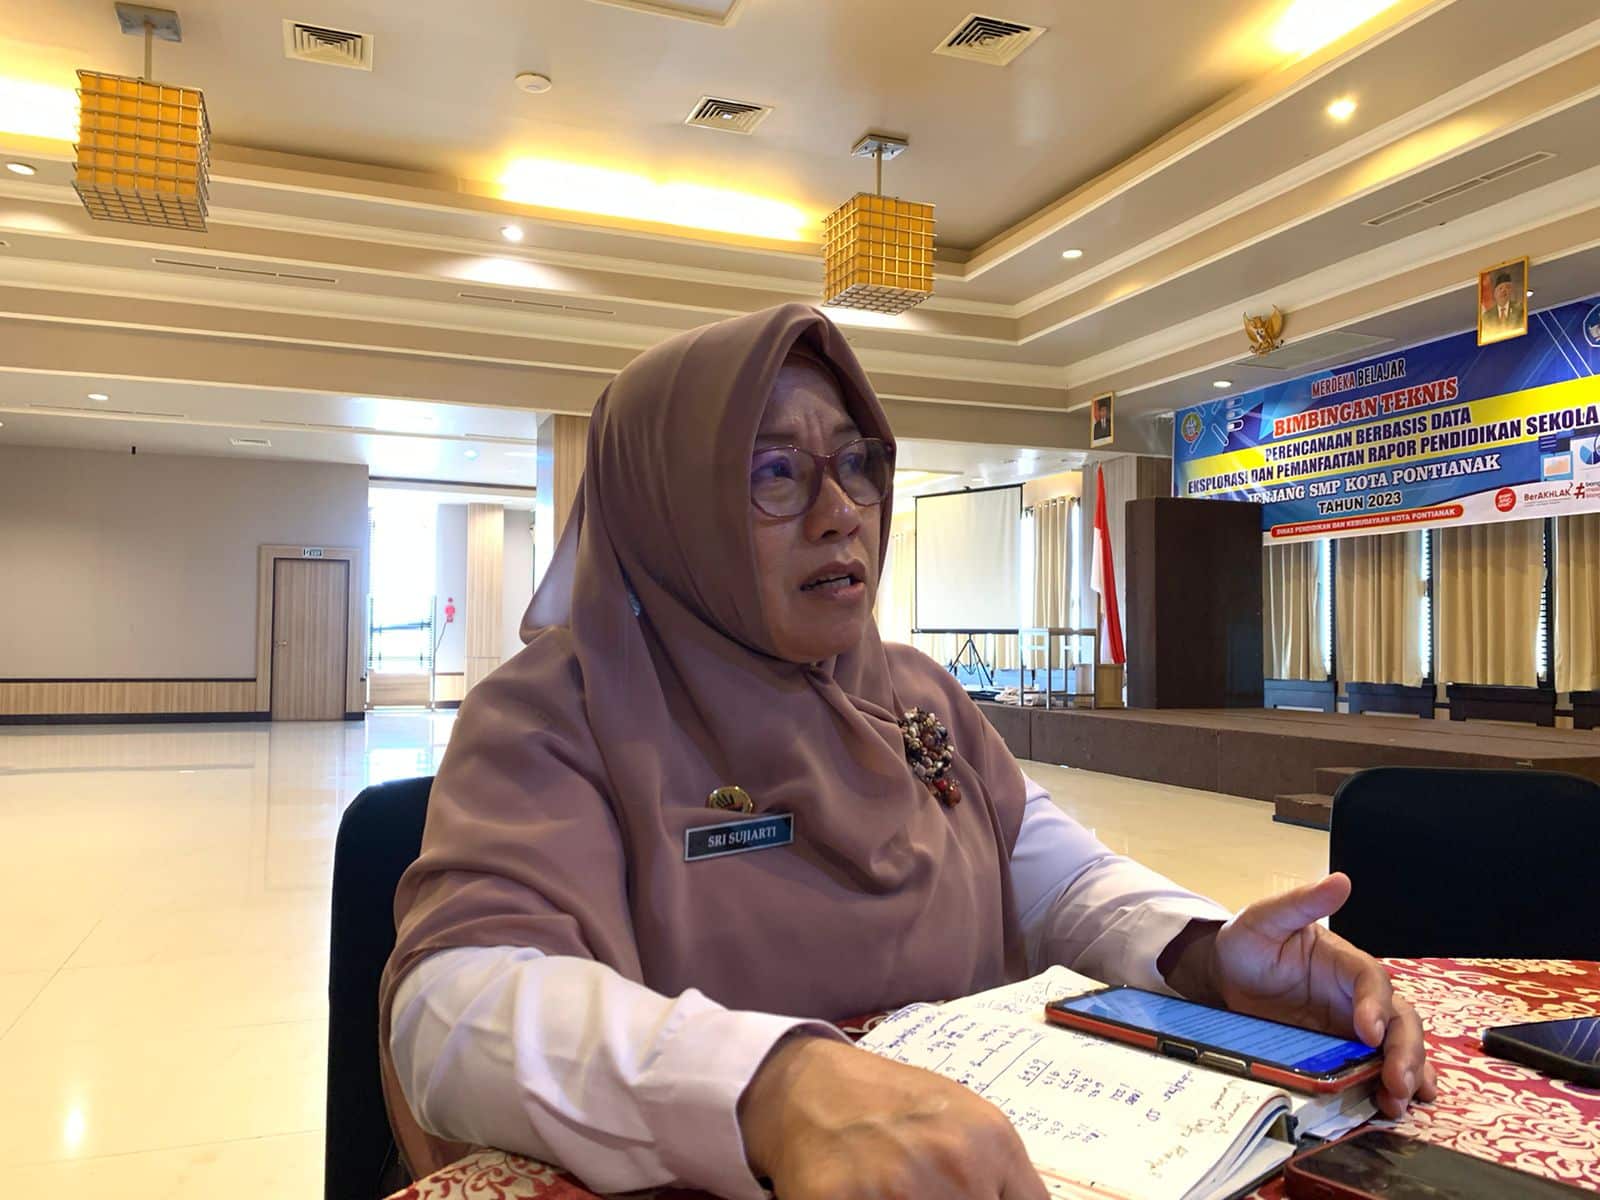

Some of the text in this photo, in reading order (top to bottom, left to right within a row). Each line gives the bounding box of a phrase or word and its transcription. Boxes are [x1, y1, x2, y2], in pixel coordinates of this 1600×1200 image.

[1311, 358, 1406, 398] MERDEKA BELAJAR
[1274, 376, 1459, 437] BIMBINGAN TEKNIS
[1188, 470, 1248, 494] EKSPLORASI
[1251, 465, 1274, 484] DAN
[1276, 448, 1365, 480] PEMANFAATAN
[1367, 438, 1417, 464] RAPOR
[1420, 419, 1522, 454] PENDIDIKAN
[1265, 406, 1472, 462] PERENCANAAN BERBASIS DATA
[1308, 479, 1341, 498] SMP
[1344, 470, 1389, 493] KOTA
[1391, 453, 1501, 486] PONTIANAK
[1317, 490, 1403, 515] TAHUN 2023
[708, 826, 777, 848] SRI SUJIARTI
